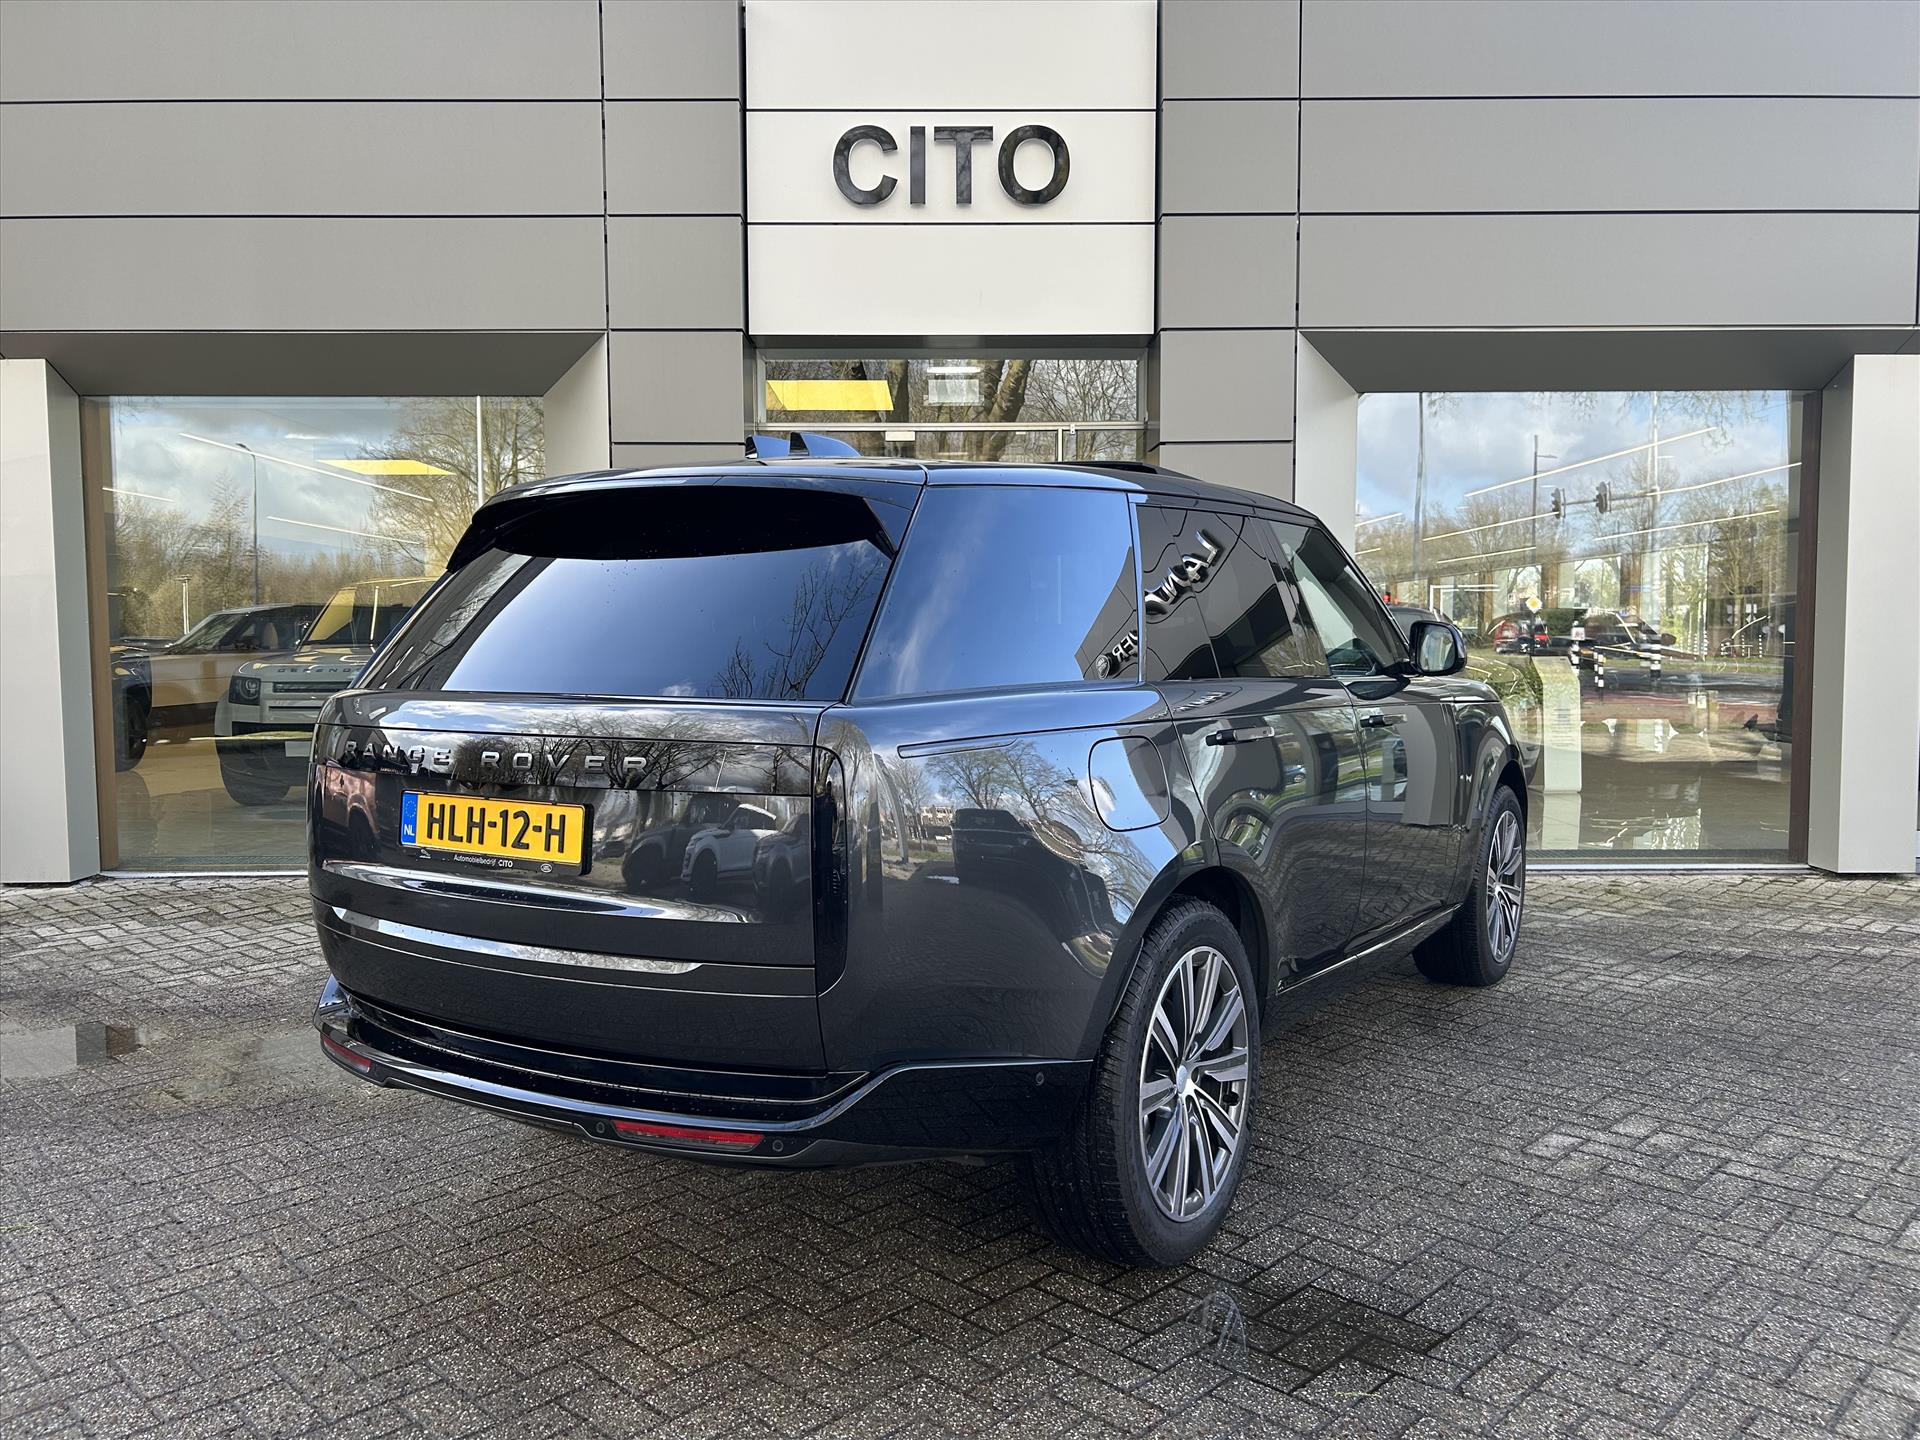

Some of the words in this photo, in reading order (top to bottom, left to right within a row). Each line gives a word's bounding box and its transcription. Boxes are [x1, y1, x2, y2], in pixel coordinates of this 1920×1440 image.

[832, 124, 1070, 206] CITO
[345, 740, 452, 766] RANGE
[481, 751, 648, 774] ROVER
[403, 824, 415, 836] NL
[427, 803, 566, 853] HLH-12-H
[498, 860, 514, 868] CITO
